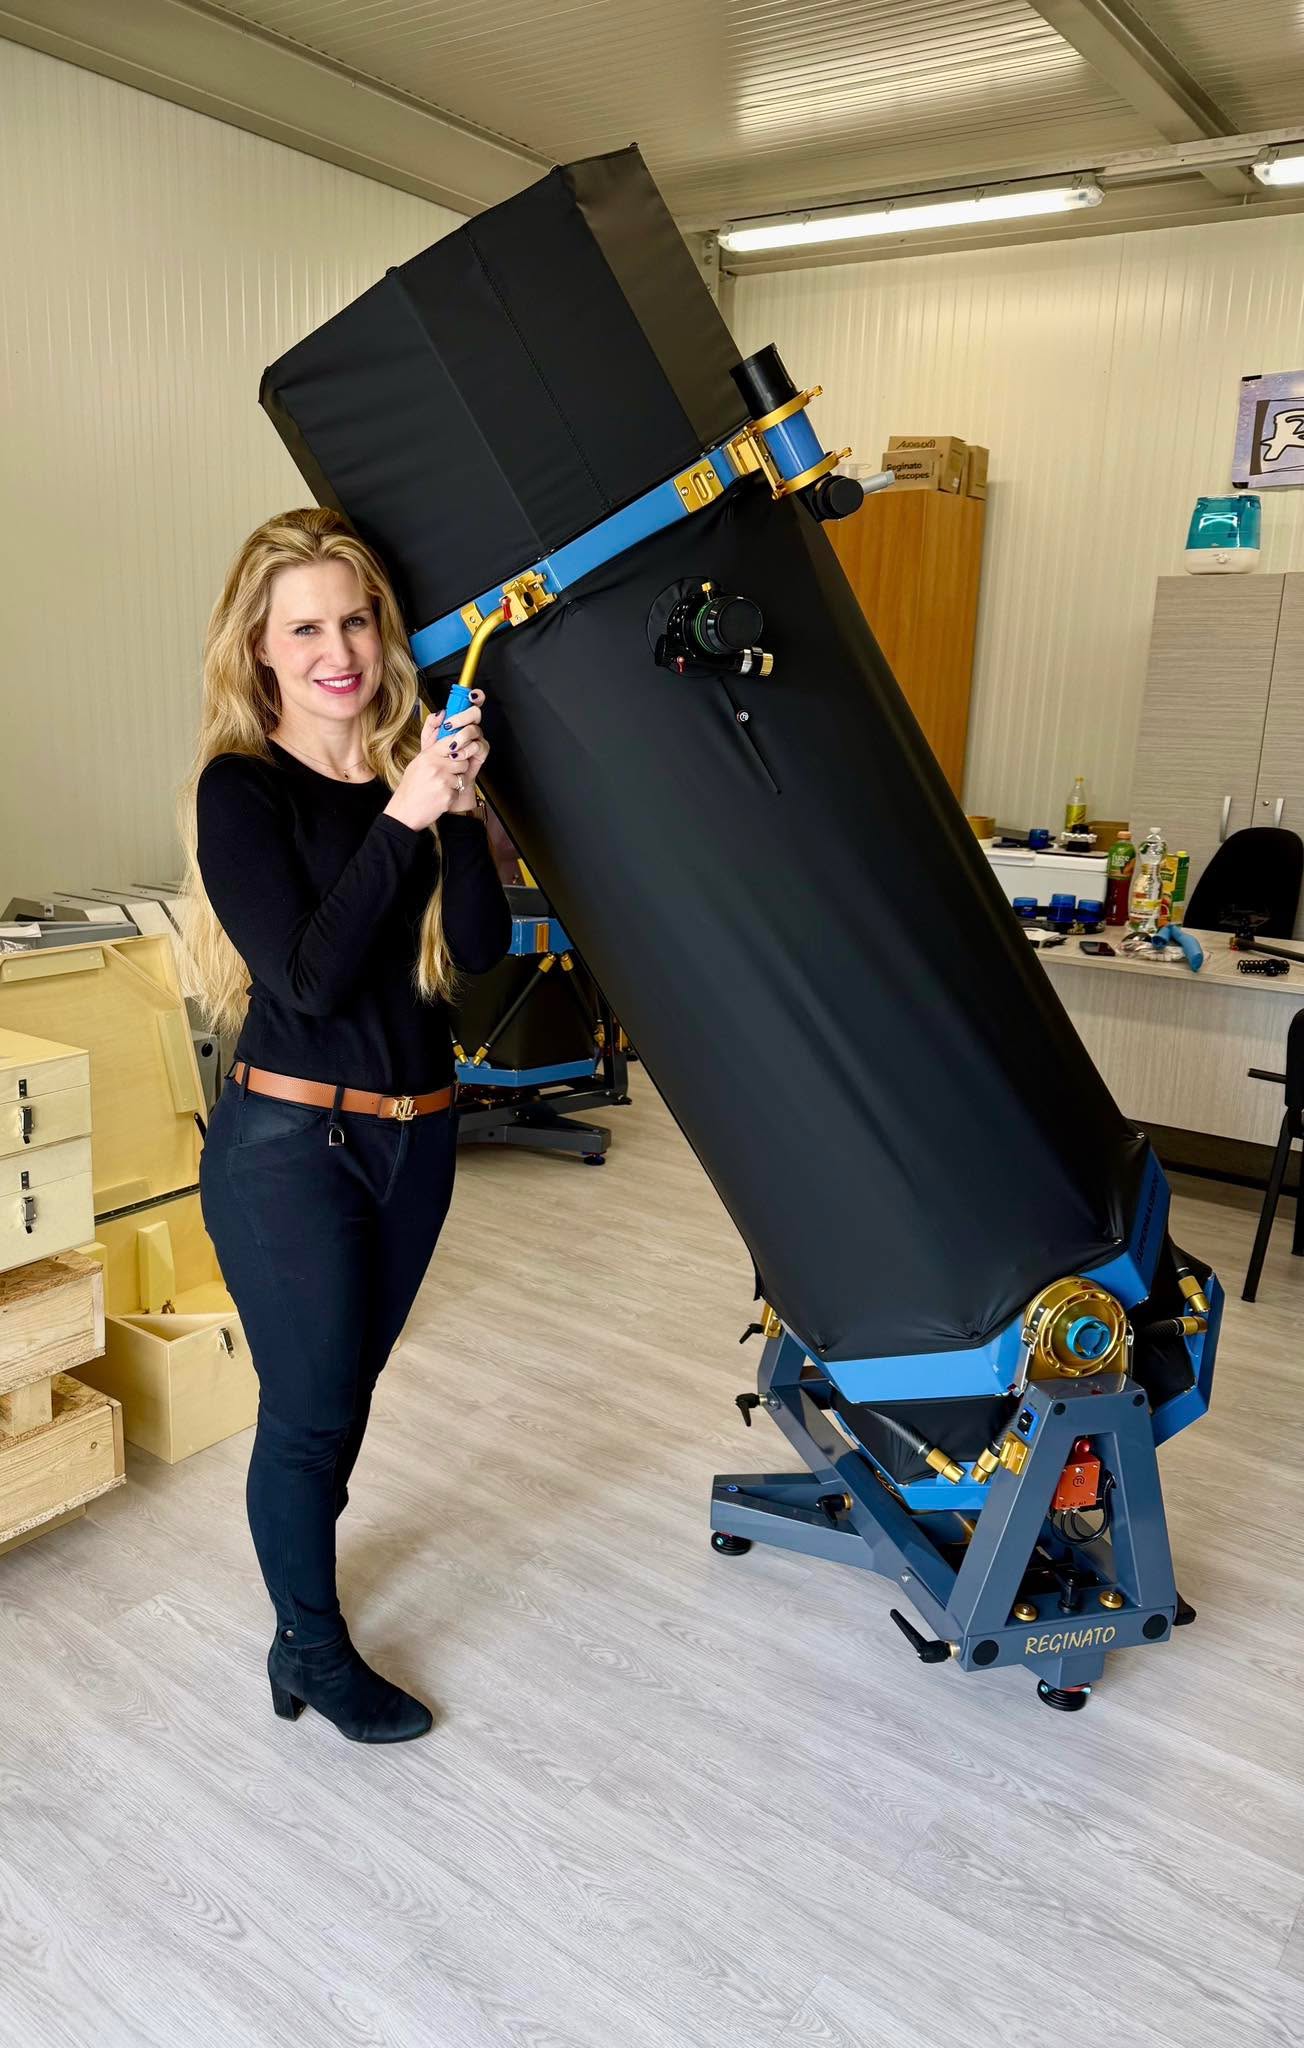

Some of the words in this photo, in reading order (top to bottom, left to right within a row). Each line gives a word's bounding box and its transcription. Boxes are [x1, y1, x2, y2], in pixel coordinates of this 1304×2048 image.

[886, 462, 922, 471] Reginato
[895, 471, 930, 480] lescopes
[1025, 1626, 1116, 1655] REGINATO
